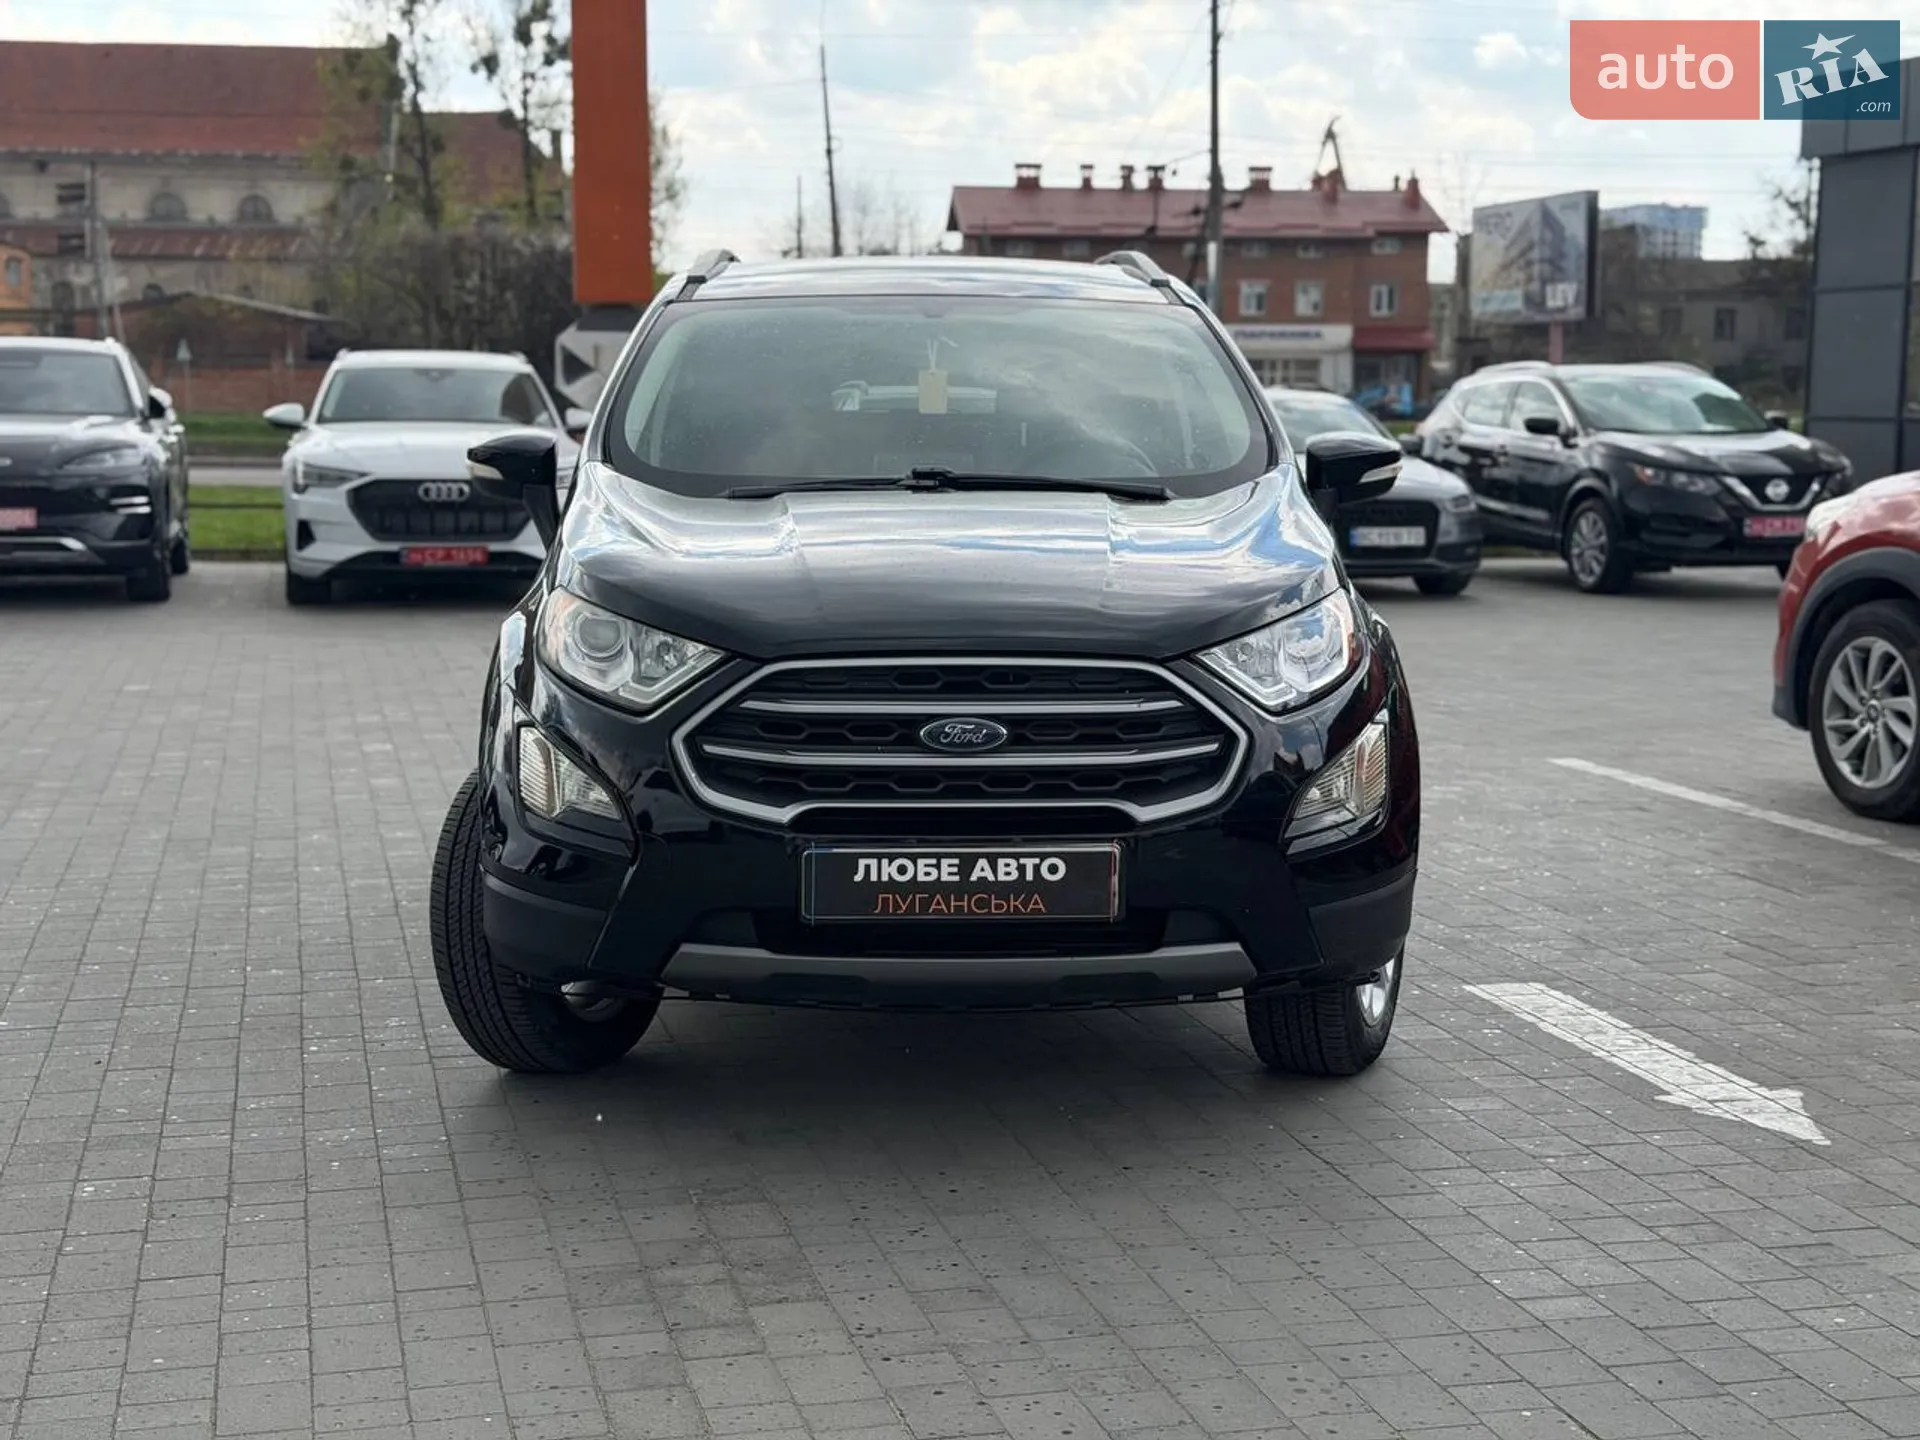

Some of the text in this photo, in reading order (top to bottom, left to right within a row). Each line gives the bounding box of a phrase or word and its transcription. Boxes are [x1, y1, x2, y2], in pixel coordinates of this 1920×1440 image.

[940, 723, 988, 743] Ford
[853, 857, 1067, 882] ЛЮБЕ АВТО
[873, 892, 1047, 914] ЛУГАНСЬКА
